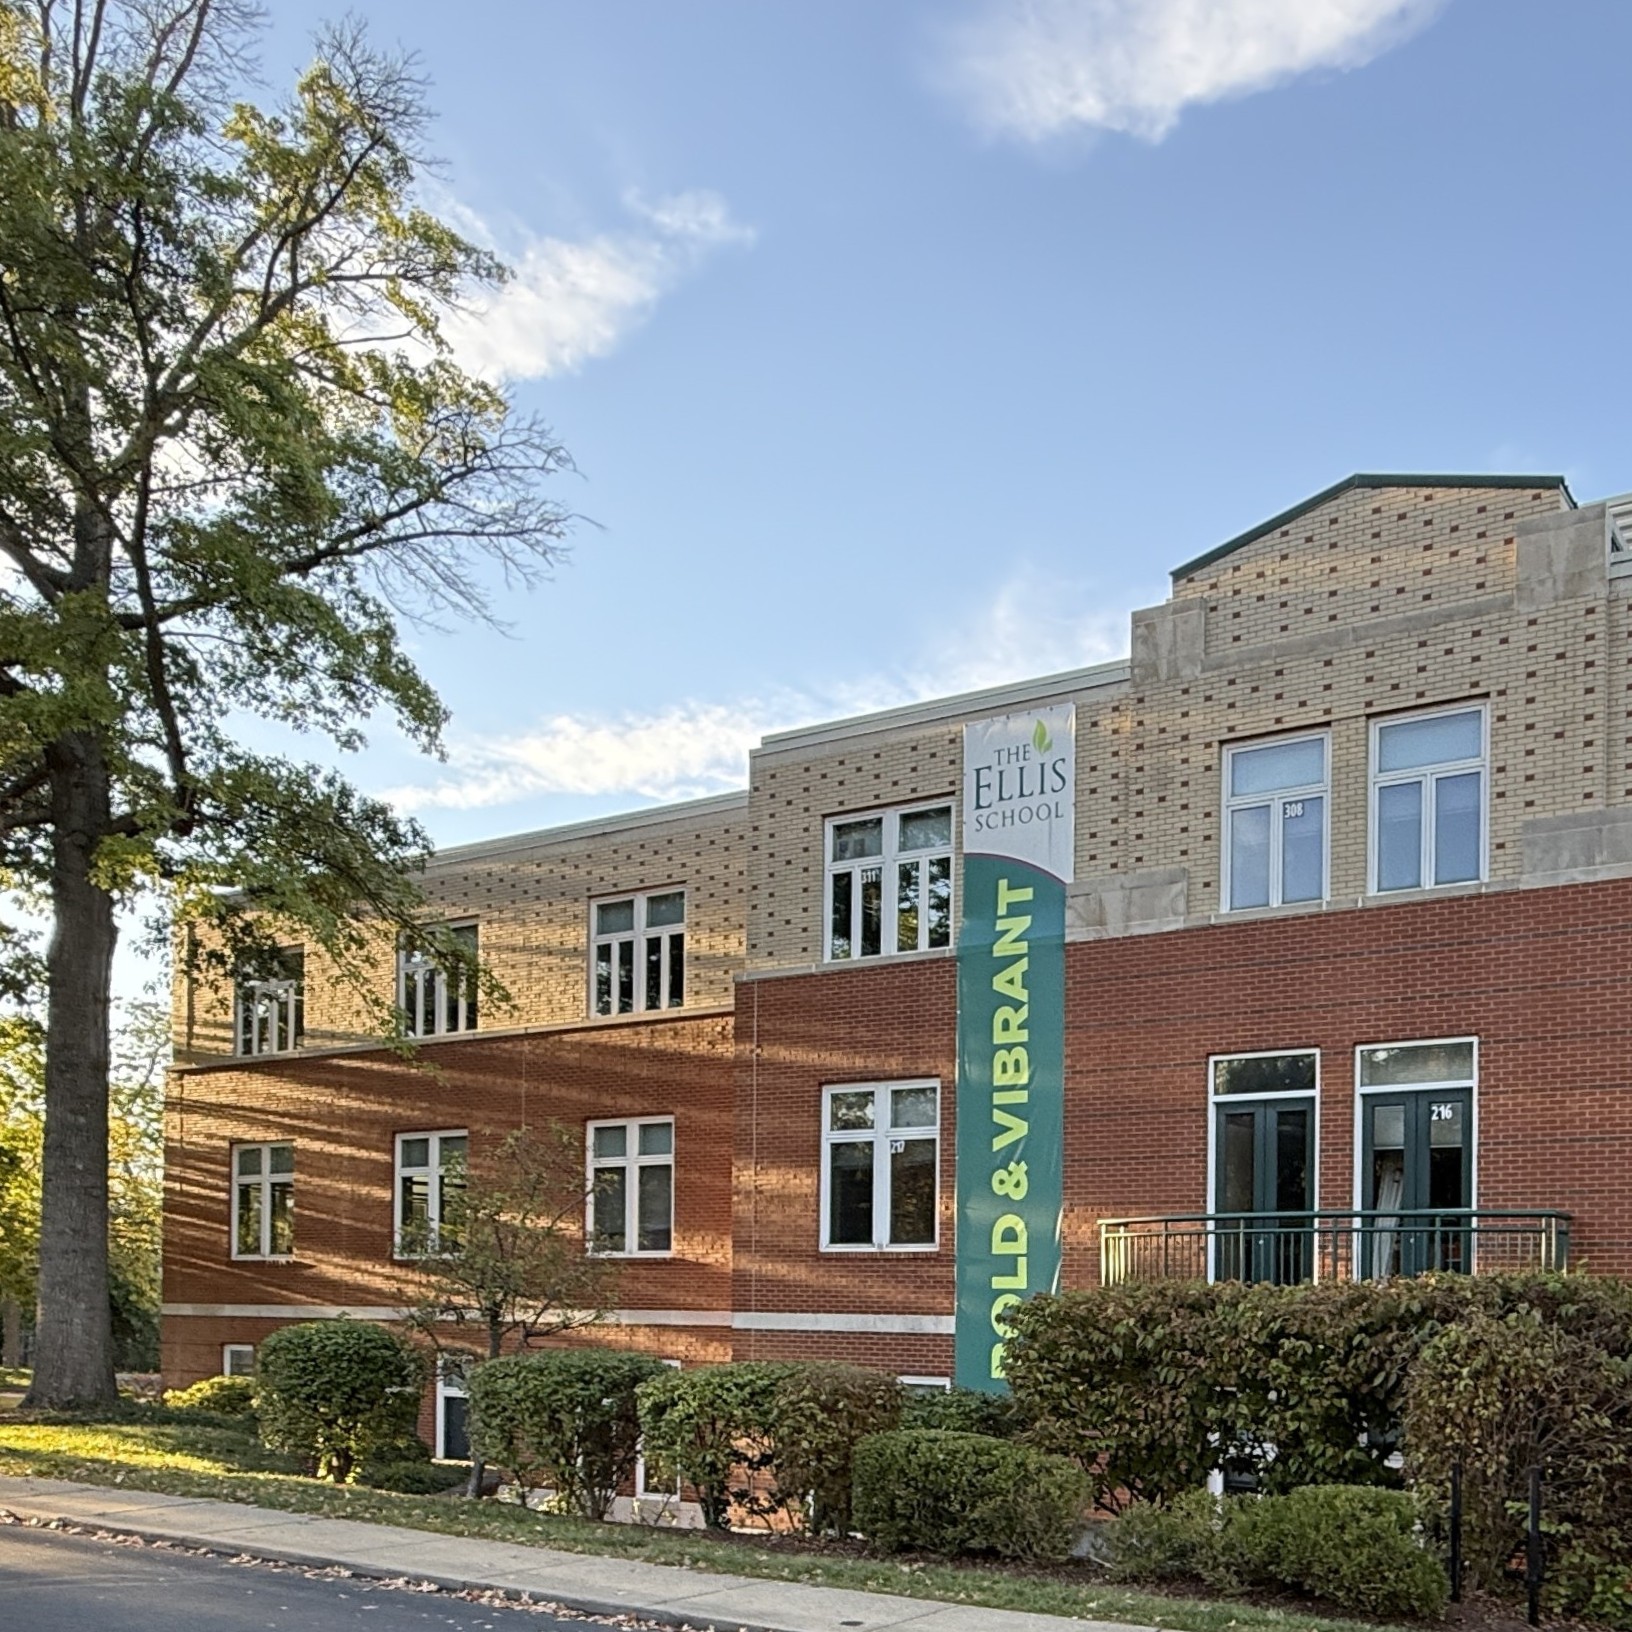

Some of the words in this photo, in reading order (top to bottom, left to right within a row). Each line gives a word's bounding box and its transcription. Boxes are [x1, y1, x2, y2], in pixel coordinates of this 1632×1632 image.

[993, 744, 1031, 766] THE
[973, 758, 1066, 811] ELLIS
[975, 801, 1064, 833] SCHOOL
[1284, 802, 1303, 818] 308
[992, 878, 1034, 1152] VIBRANT
[1431, 1104, 1453, 1121] 216
[991, 1160, 1028, 1201] &
